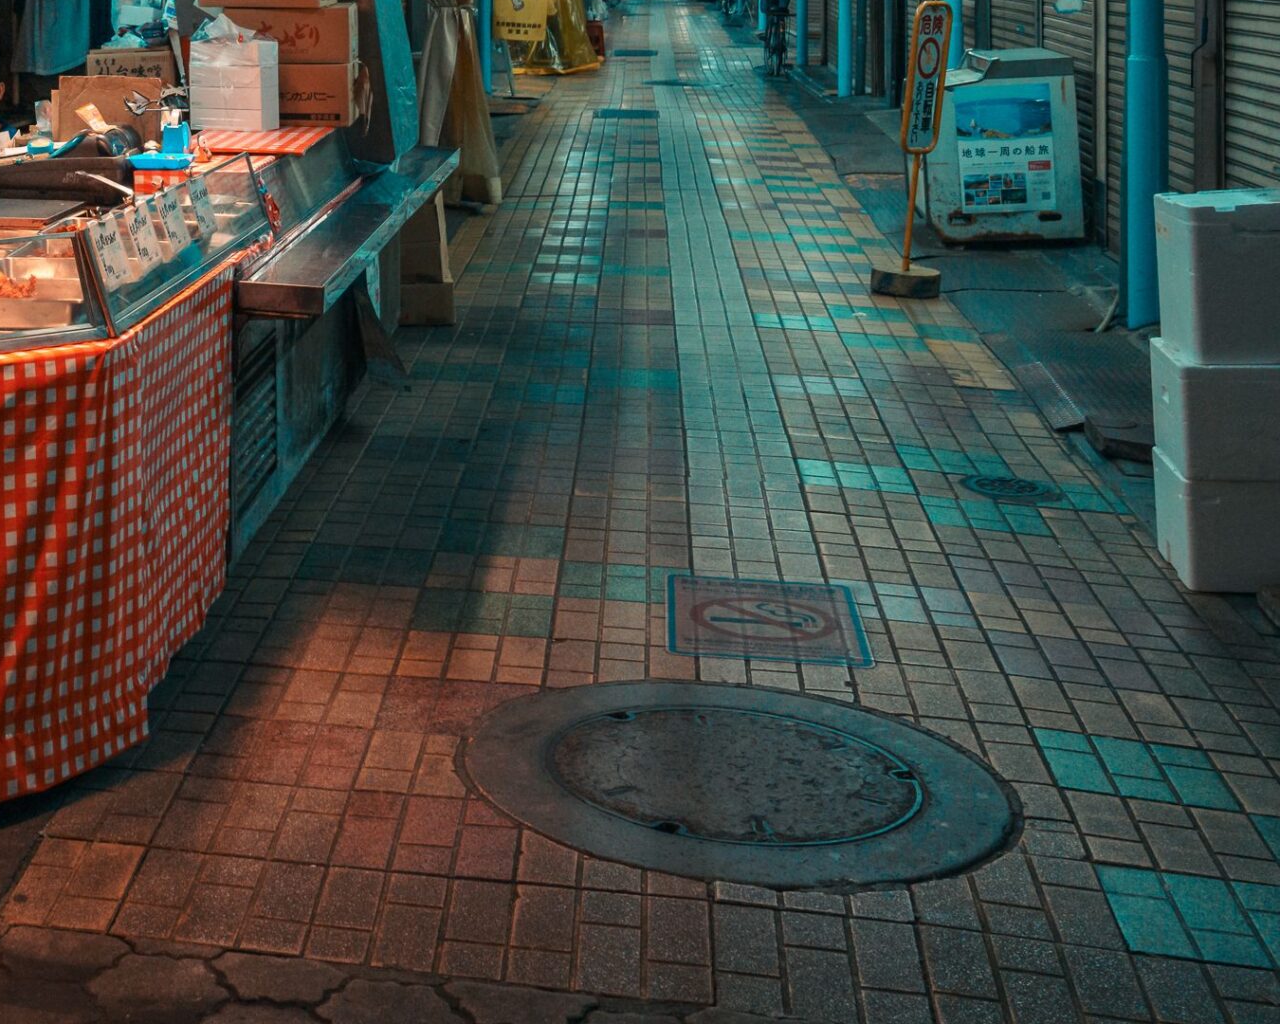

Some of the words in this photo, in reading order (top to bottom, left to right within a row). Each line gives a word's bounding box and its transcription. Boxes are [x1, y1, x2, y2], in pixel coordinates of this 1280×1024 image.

[921, 15, 944, 35] 危険
[962, 144, 1050, 158] 地球一周の船旅
